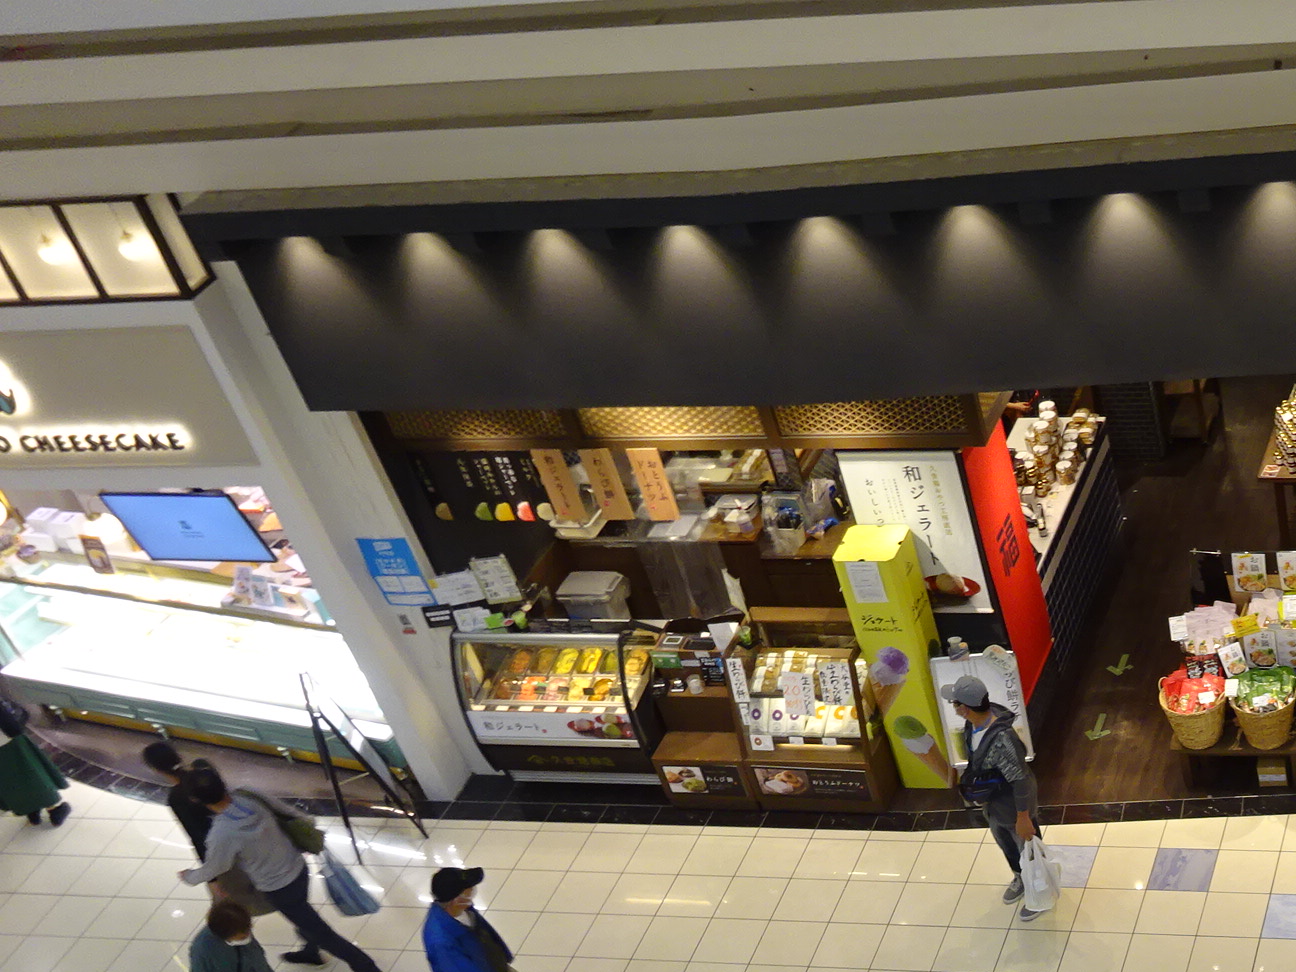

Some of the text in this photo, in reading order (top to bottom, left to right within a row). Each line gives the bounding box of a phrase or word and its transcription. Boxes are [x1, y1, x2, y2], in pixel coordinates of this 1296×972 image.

[19, 432, 185, 453] CHEESECAKE
[902, 464, 940, 566] 和ジェラート
